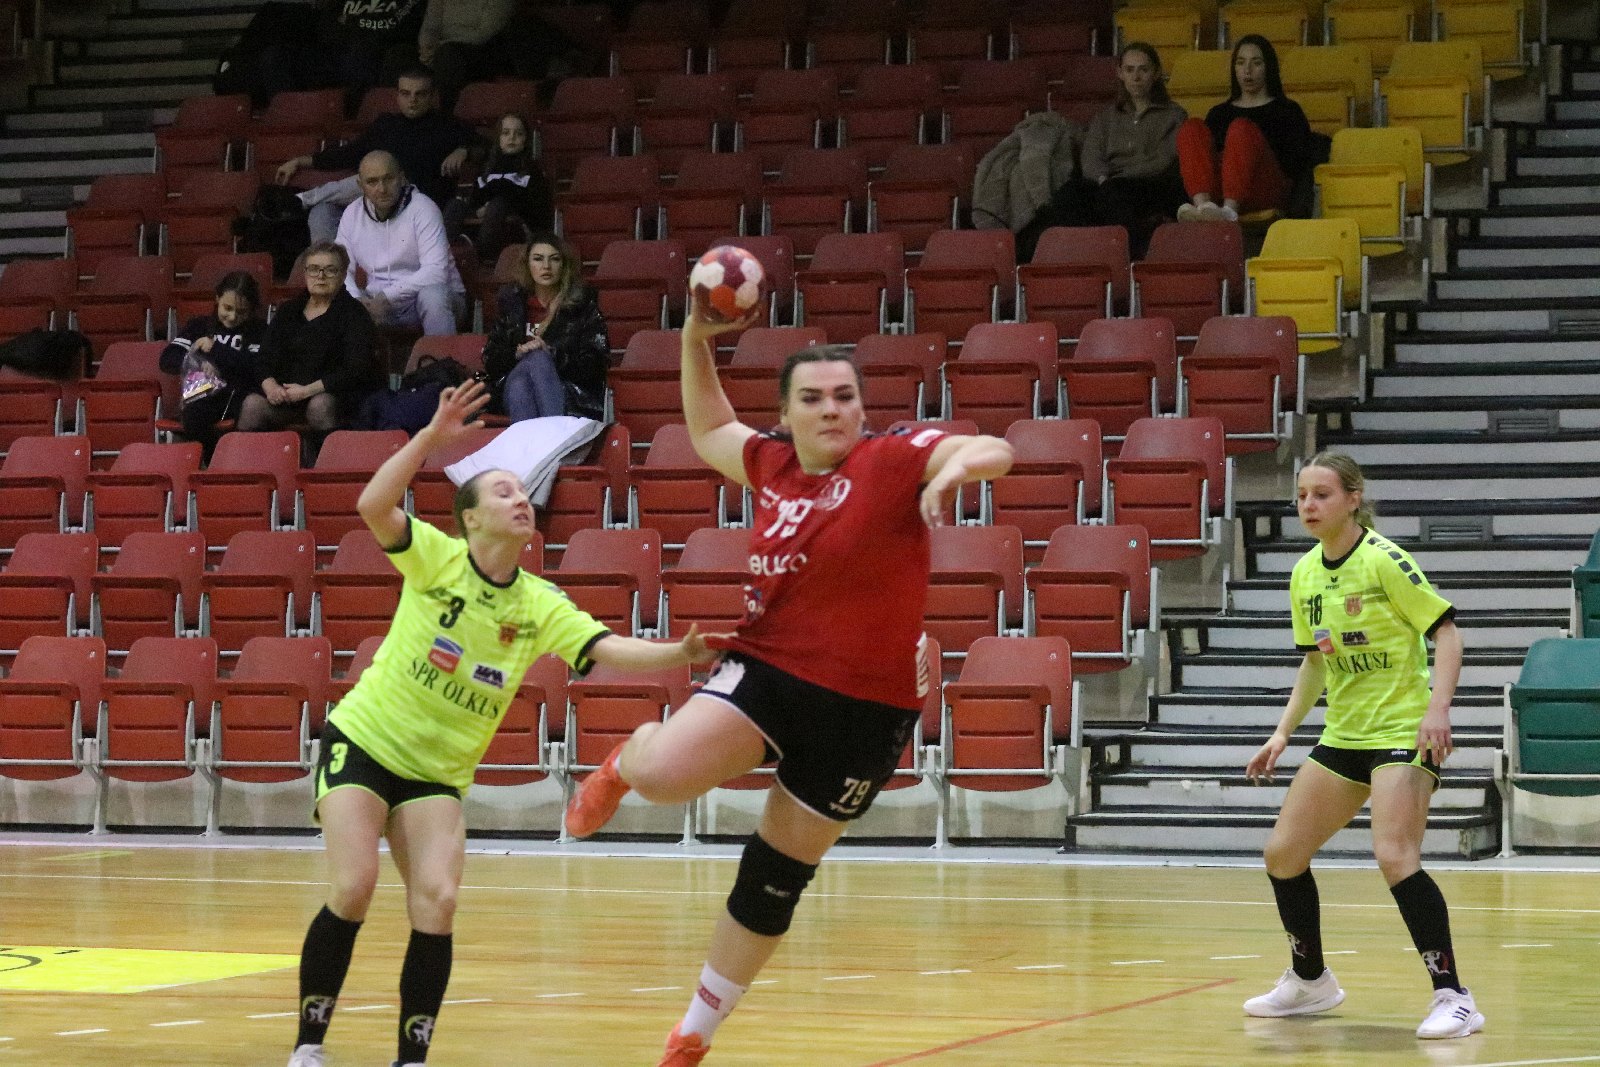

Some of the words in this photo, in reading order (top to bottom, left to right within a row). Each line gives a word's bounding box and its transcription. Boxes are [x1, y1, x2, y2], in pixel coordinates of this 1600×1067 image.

[763, 497, 814, 539] 79
[438, 595, 466, 629] 3
[1307, 593, 1322, 627] 18
[408, 656, 440, 691] SPR
[329, 742, 349, 775] 3
[838, 777, 872, 804] 79
